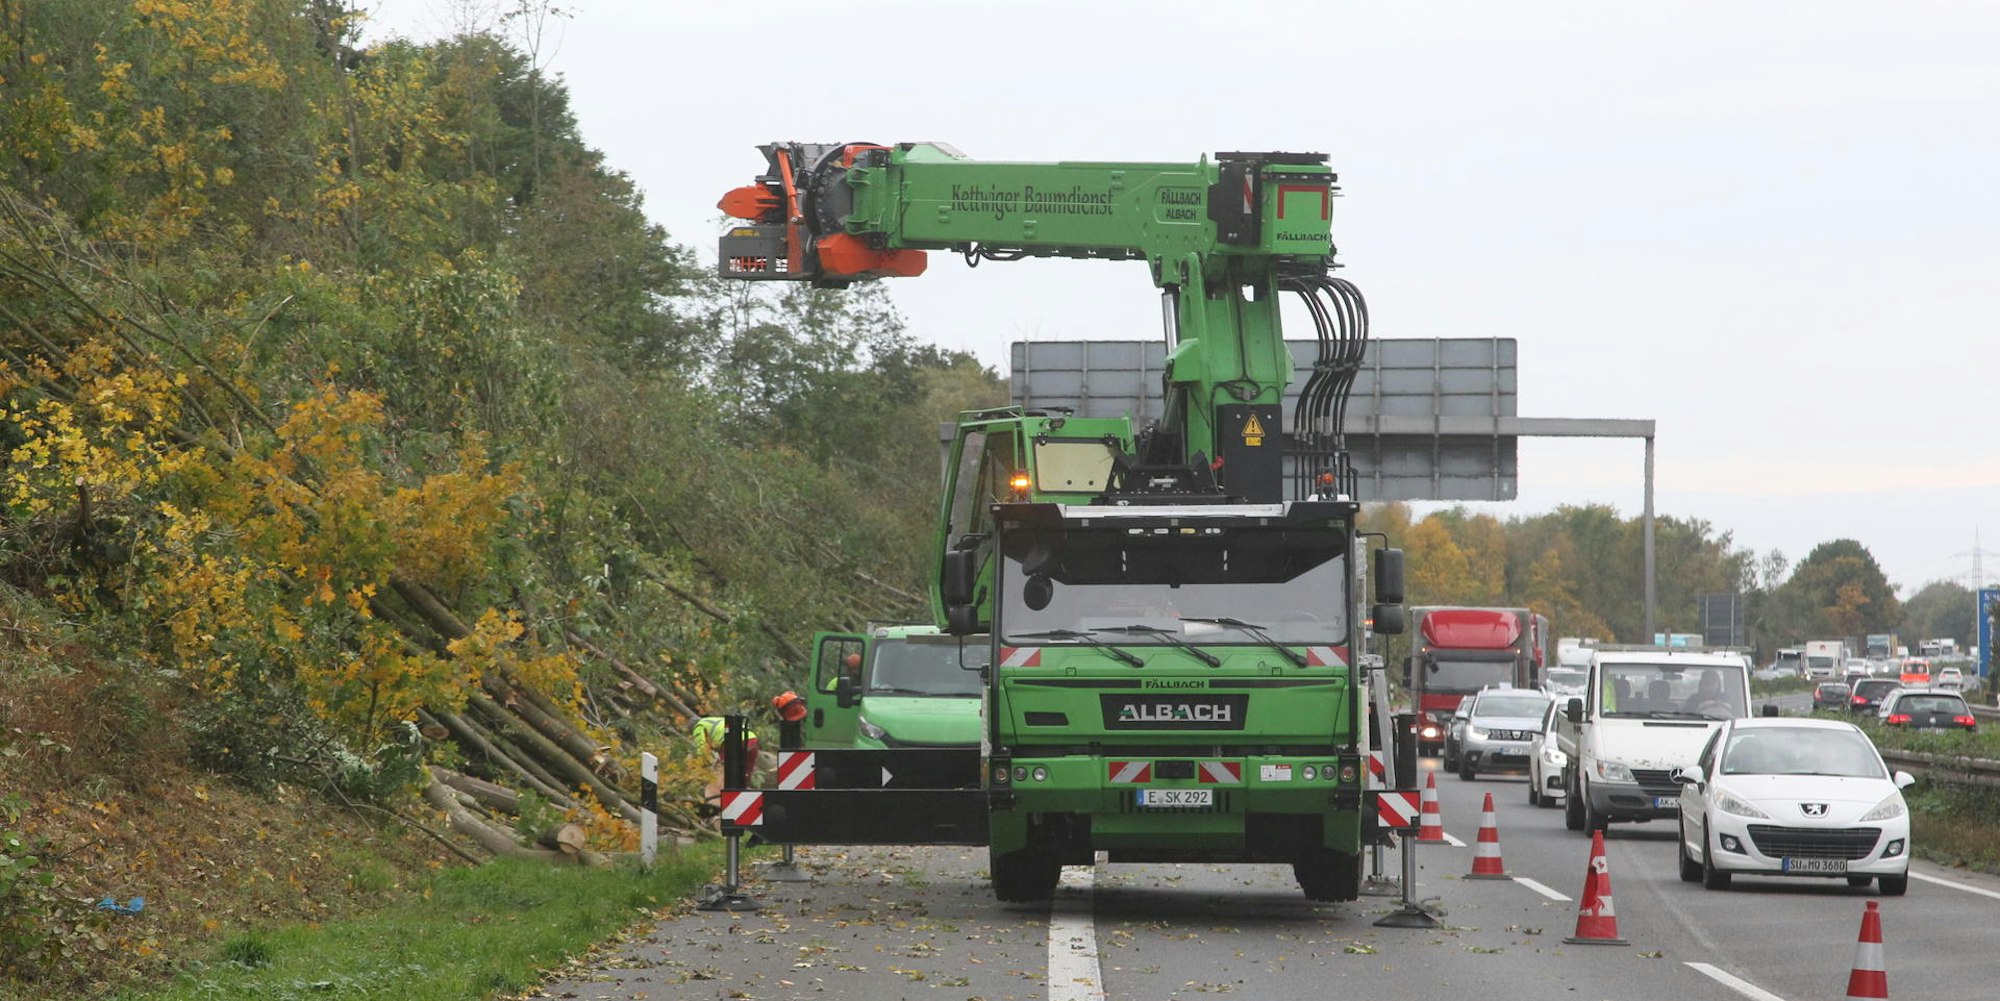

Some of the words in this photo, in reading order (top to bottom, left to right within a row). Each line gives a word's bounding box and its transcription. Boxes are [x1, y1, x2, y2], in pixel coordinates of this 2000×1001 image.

[951, 183, 1020, 221] Kettwiger
[1024, 185, 1115, 215] Baumdienst
[1161, 188, 1201, 205] FÄLLBACH
[1166, 208, 1197, 220] ALBACH
[1276, 231, 1327, 242] FÄLLBACH
[1145, 678, 1205, 689] FÄLLBACH
[1118, 703, 1232, 722] ALBACH
[1148, 791, 1155, 804] E
[1165, 791, 1182, 804] SK
[1184, 791, 1208, 804] 292
